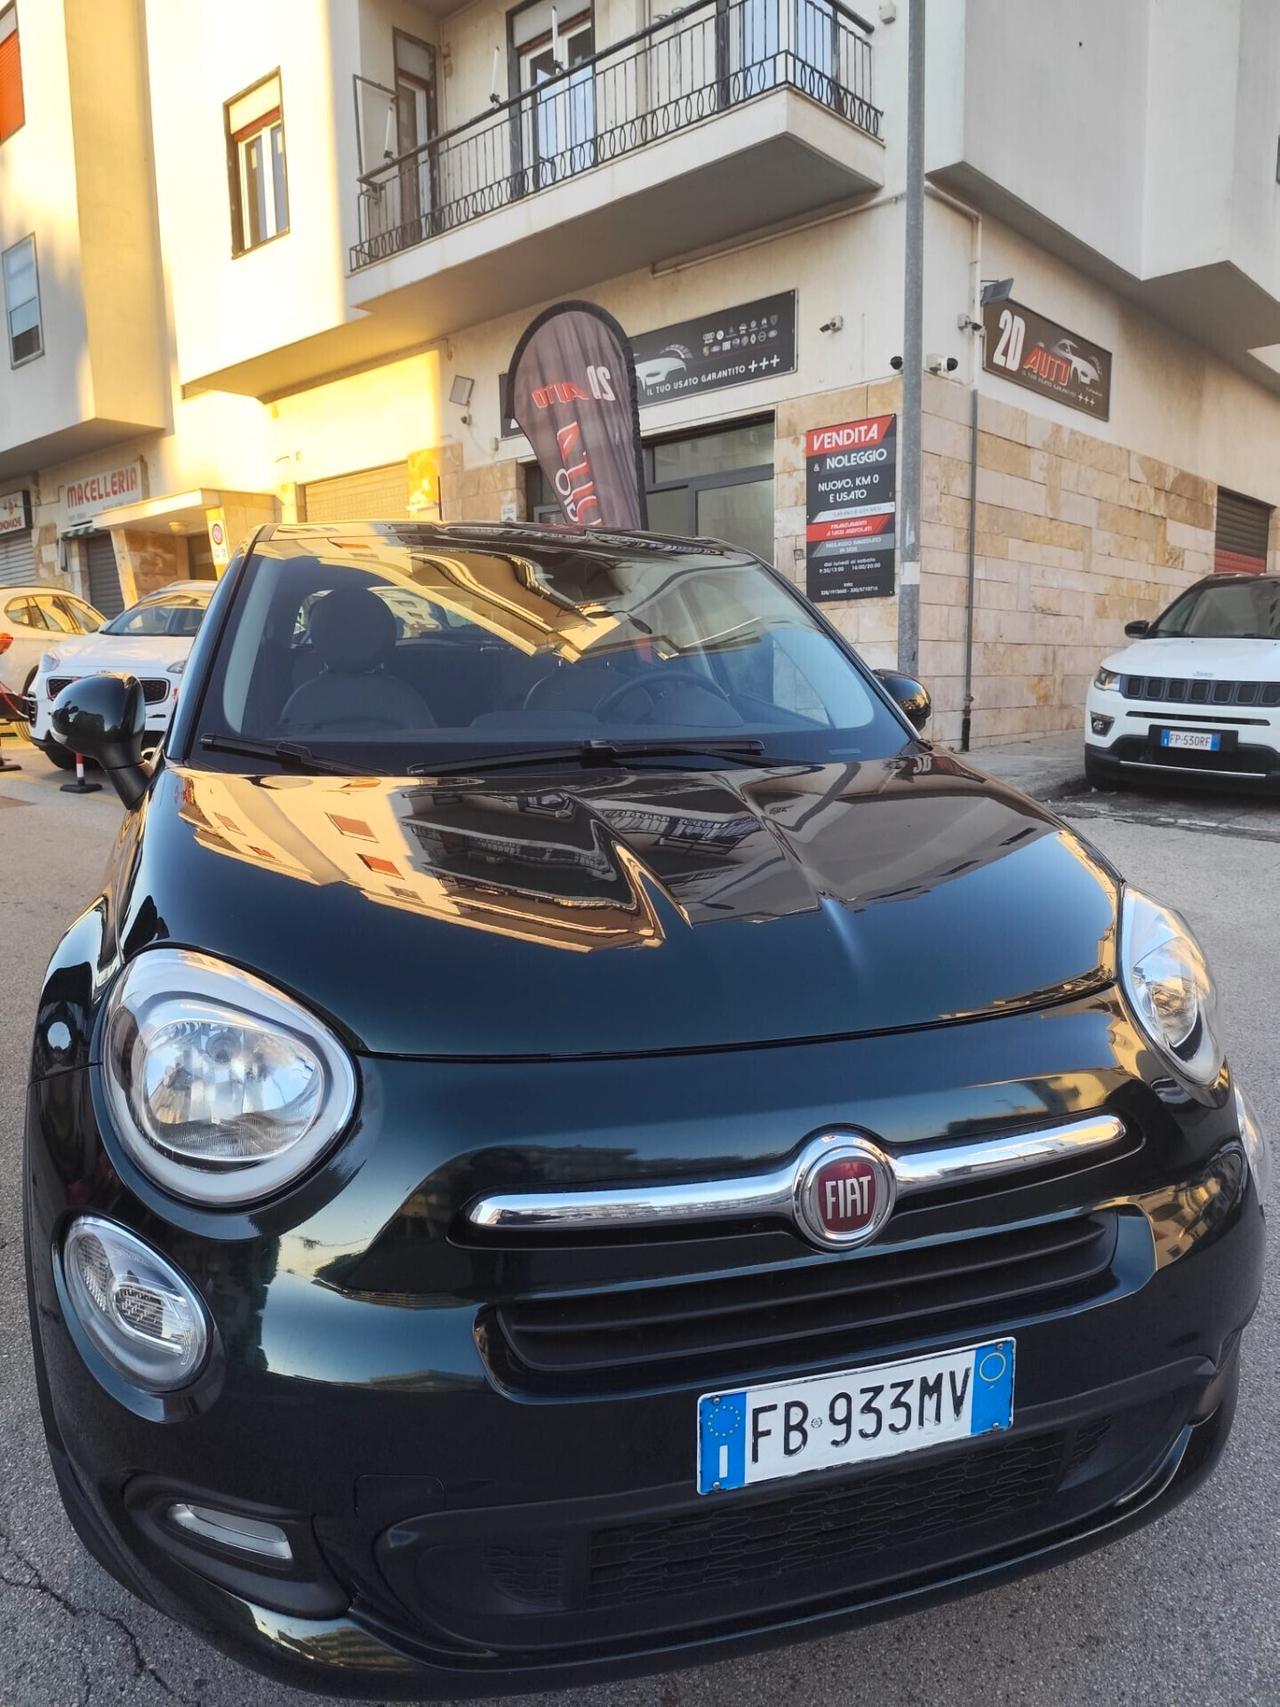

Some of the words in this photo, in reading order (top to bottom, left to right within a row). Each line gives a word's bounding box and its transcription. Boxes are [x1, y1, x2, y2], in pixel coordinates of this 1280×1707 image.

[992, 309, 1026, 372] 2D
[1022, 344, 1072, 387] AUTO
[656, 383, 672, 394] TUO
[673, 376, 699, 390] USATO
[701, 365, 746, 383] GARANTITO
[813, 423, 878, 451] VENDITA
[826, 448, 887, 470] NOLEGGIO
[66, 466, 138, 509] MACELLERIA
[855, 475, 871, 486] KM
[829, 493, 835, 503] E
[836, 489, 867, 502] USATO
[825, 1175, 872, 1220] FIAT
